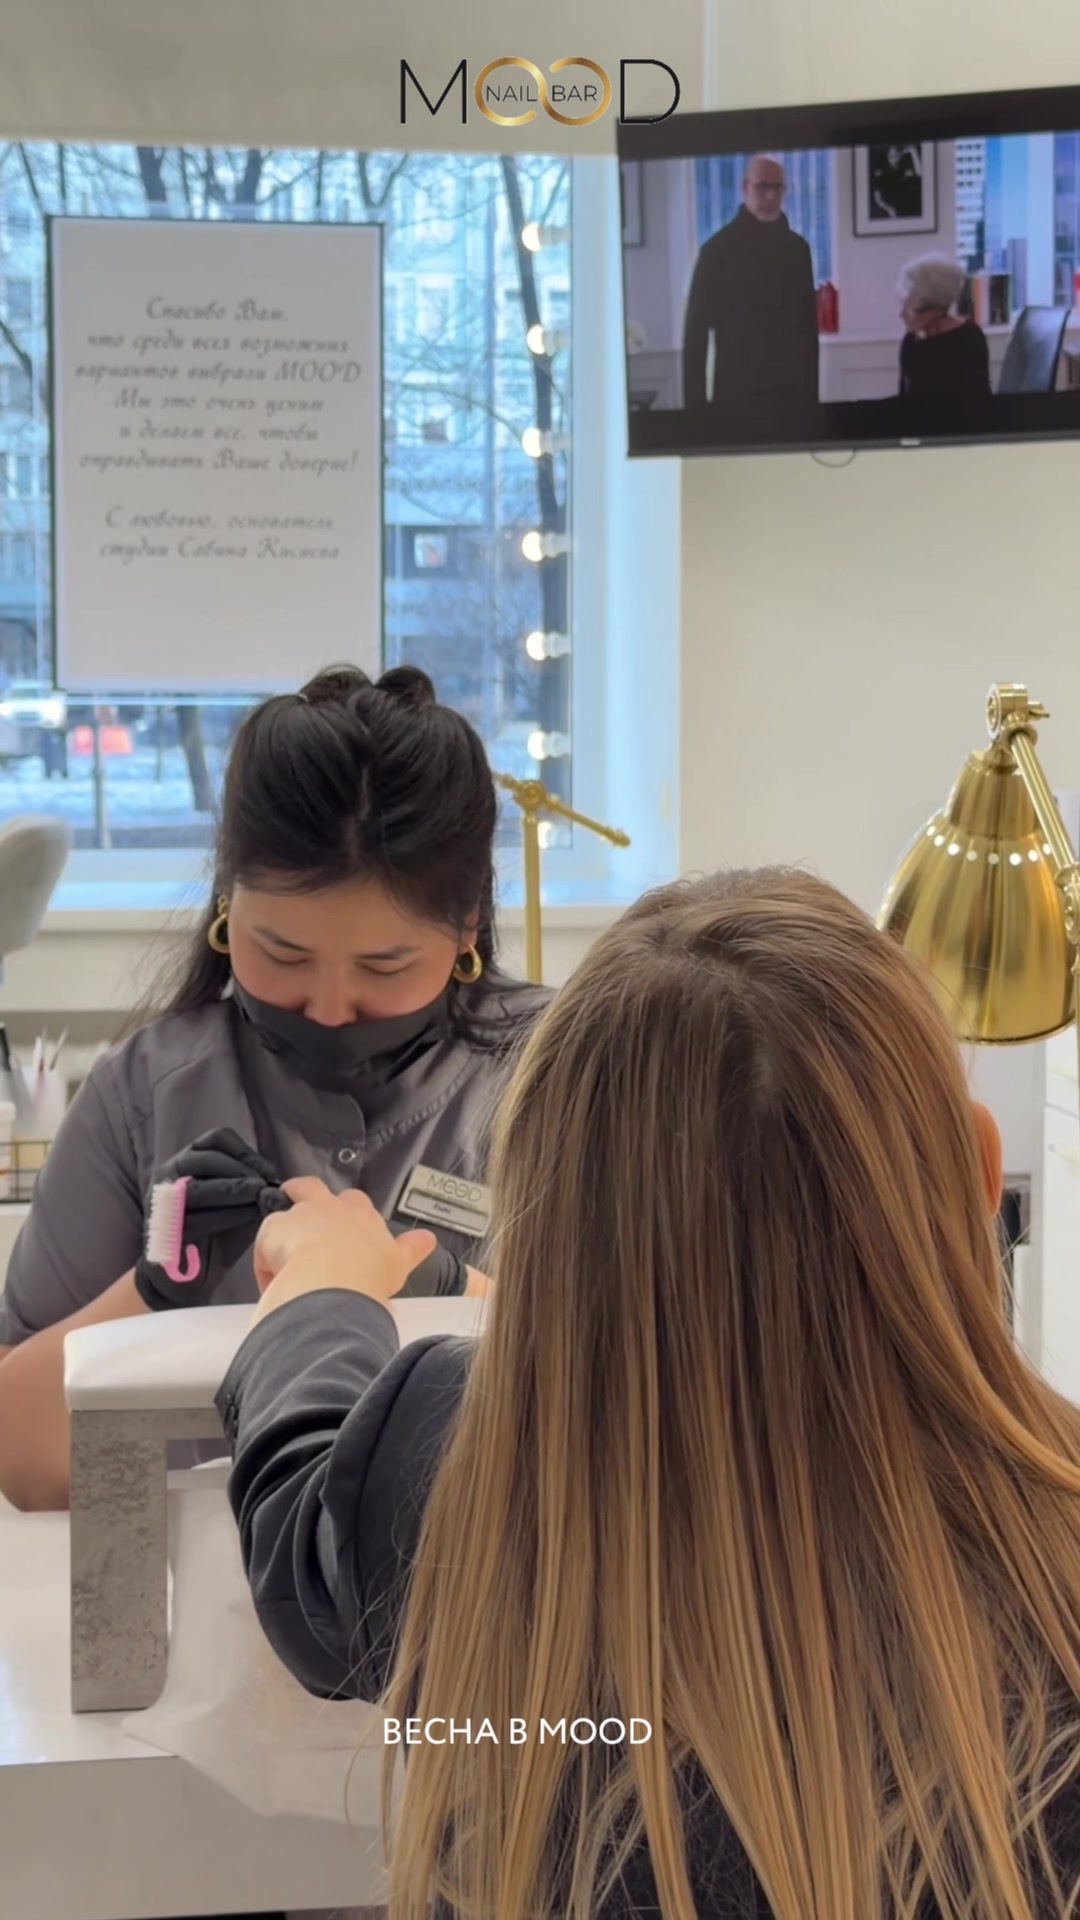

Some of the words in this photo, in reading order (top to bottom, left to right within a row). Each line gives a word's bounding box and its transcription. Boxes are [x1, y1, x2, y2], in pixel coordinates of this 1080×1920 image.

[145, 295, 226, 320] Спасибо
[87, 335, 125, 348] что
[132, 328, 184, 356] среди
[191, 336, 230, 350] всех
[240, 337, 349, 359] возможных
[75, 365, 179, 384] вариантов
[187, 361, 267, 387] выбрали
[114, 387, 151, 408] Мы
[160, 396, 197, 409] это
[205, 397, 256, 410] очень
[265, 398, 324, 417] ценим
[119, 427, 131, 438] и
[139, 418, 205, 439] делаем
[257, 423, 318, 441] чтобы
[212, 447, 271, 470] Ваше
[105, 504, 126, 528] С
[227, 515, 334, 530] основатель
[99, 536, 169, 566] студии
[177, 535, 248, 558] Сабина
